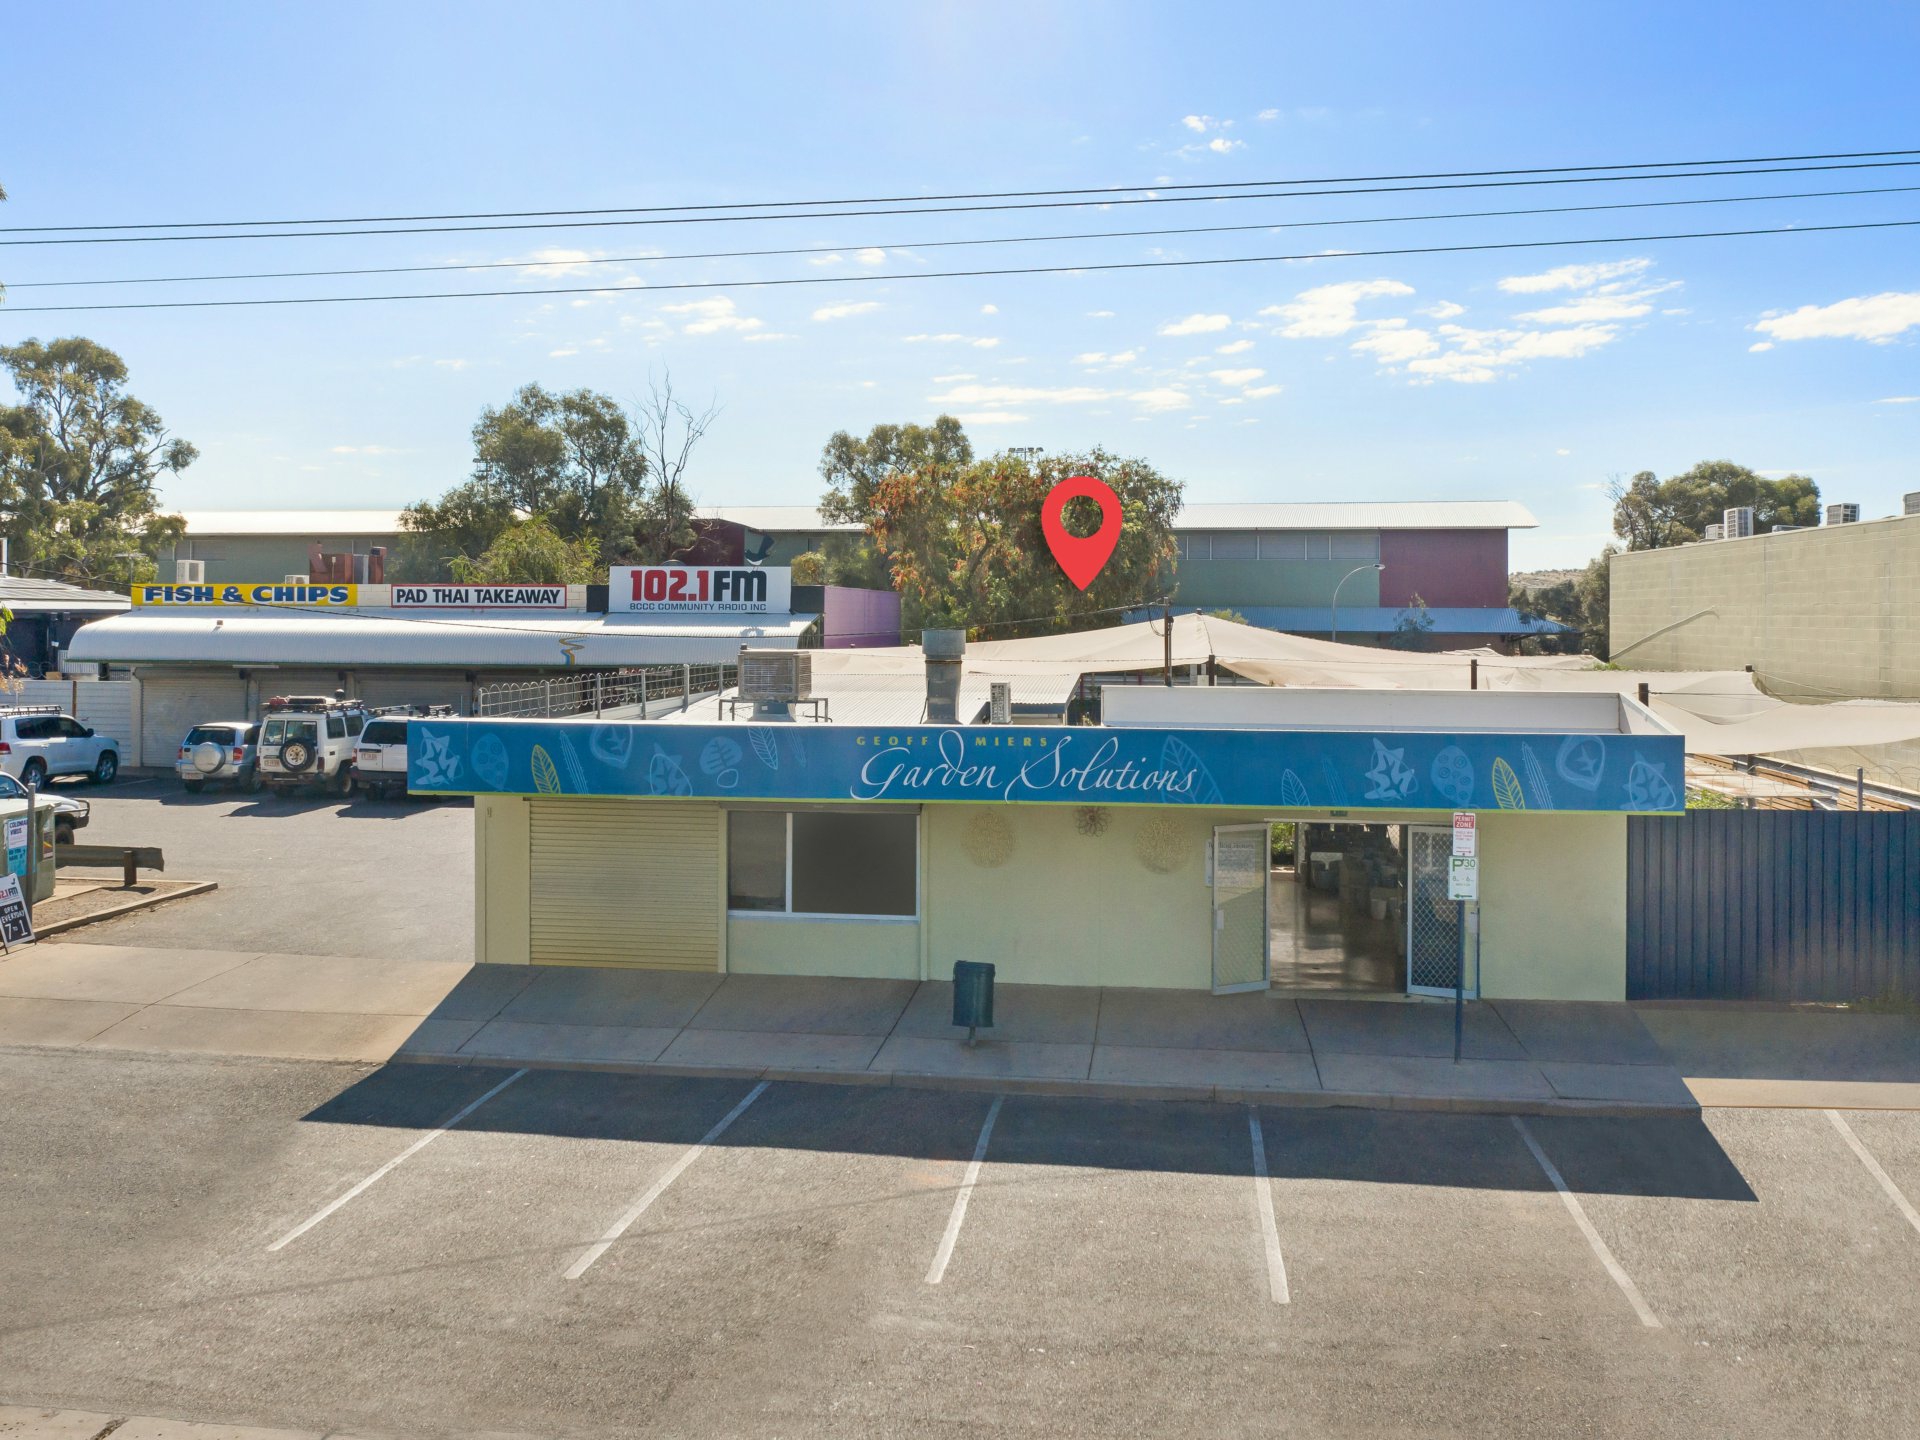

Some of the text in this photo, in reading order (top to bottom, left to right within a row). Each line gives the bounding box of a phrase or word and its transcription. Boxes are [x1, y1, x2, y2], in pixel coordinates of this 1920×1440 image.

[142, 585, 349, 604] FISH & CHIPS
[396, 588, 561, 604] PAD THAI TAKEAWAY
[629, 602, 767, 611] 8CCC COMMUNITY RADIO INC
[856, 736, 1048, 747] GEOFF MIERS
[850, 730, 1197, 804] Garden Solutions
[10, 820, 28, 829] COLONIA
[1452, 858, 1464, 872] P
[4, 904, 19, 914] OPEN
[4, 923, 12, 940] 7
[19, 919, 28, 937] 1
